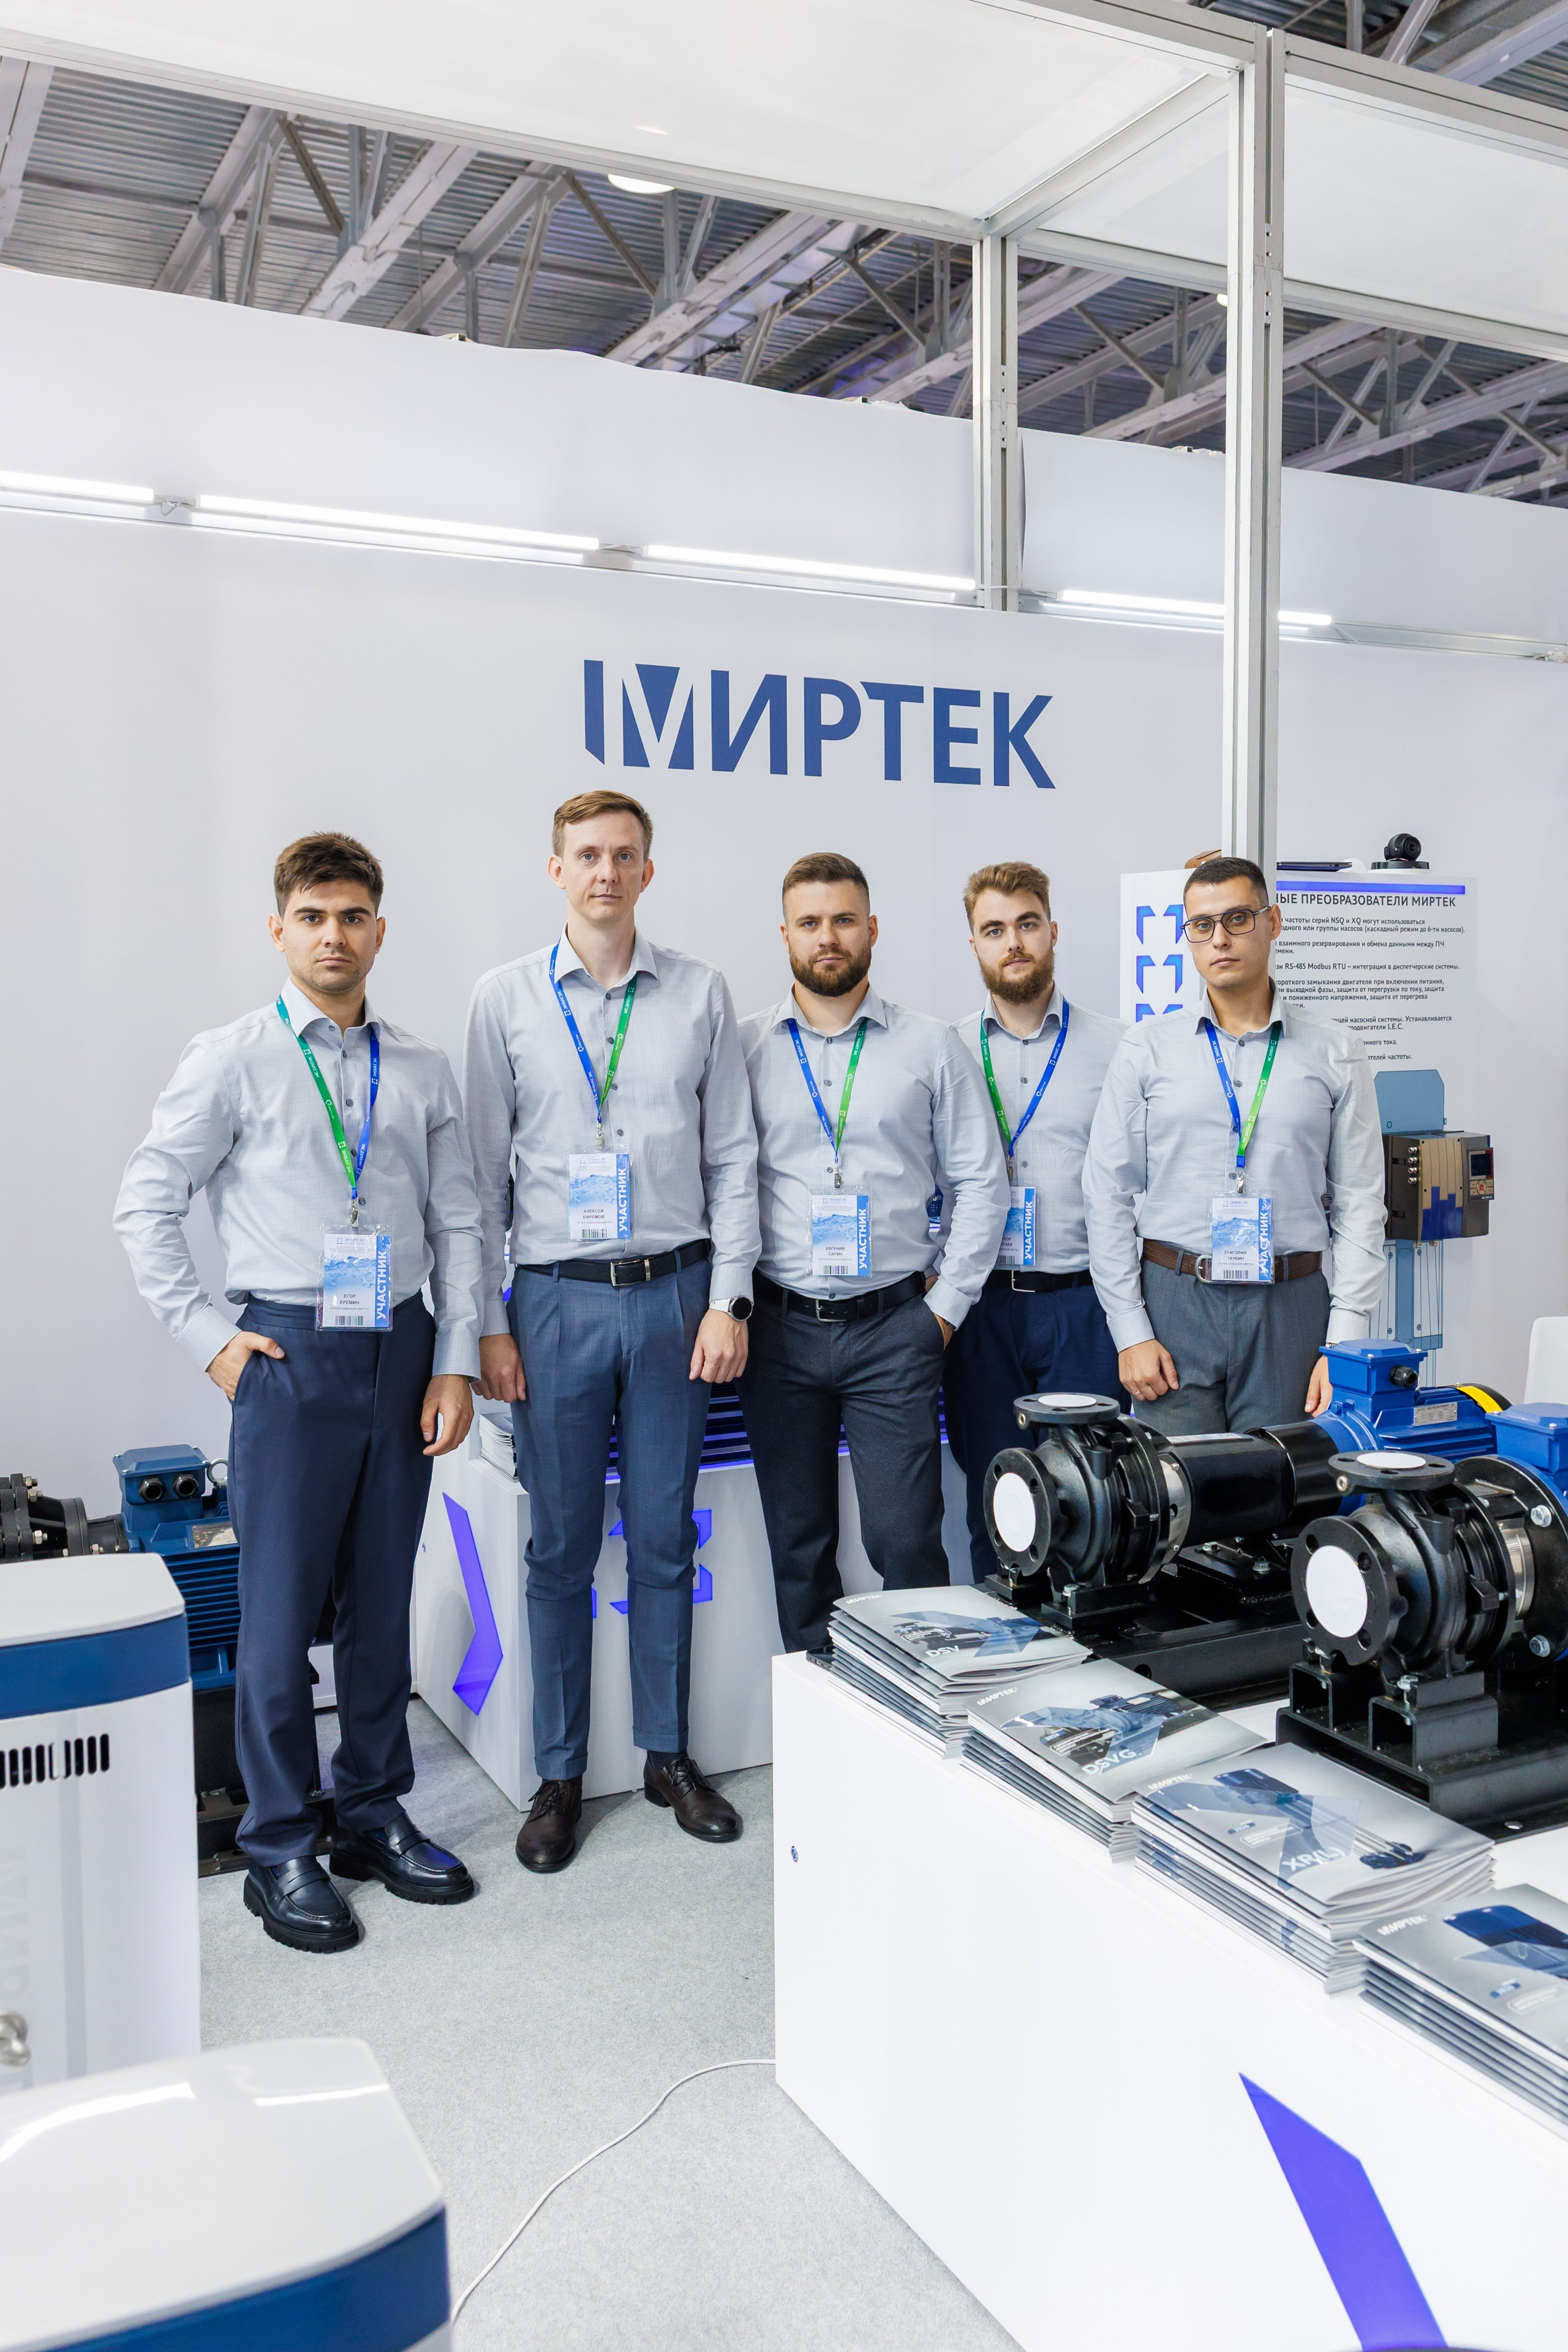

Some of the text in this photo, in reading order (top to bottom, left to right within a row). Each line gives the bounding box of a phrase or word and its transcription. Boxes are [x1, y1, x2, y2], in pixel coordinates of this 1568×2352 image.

[584, 659, 1056, 790] МИРТЕК
[1302, 894, 1409, 906] ПРЕОБРАЗОВАТЕЛИ
[1412, 895, 1457, 907] МИРТЕК
[1312, 916, 1329, 925] серий
[307, 1055, 320, 1078] ЭКВАТЭК
[618, 1167, 628, 1232] УЧАСТНИК
[858, 1208, 867, 1270] УЧАСТНИК
[1259, 1211, 1269, 1275] УЧАСТНИК
[376, 1251, 388, 1320] УЧАСТНИК
[925, 1645, 960, 1657] DSV
[1082, 1749, 1137, 1776] DSVG
